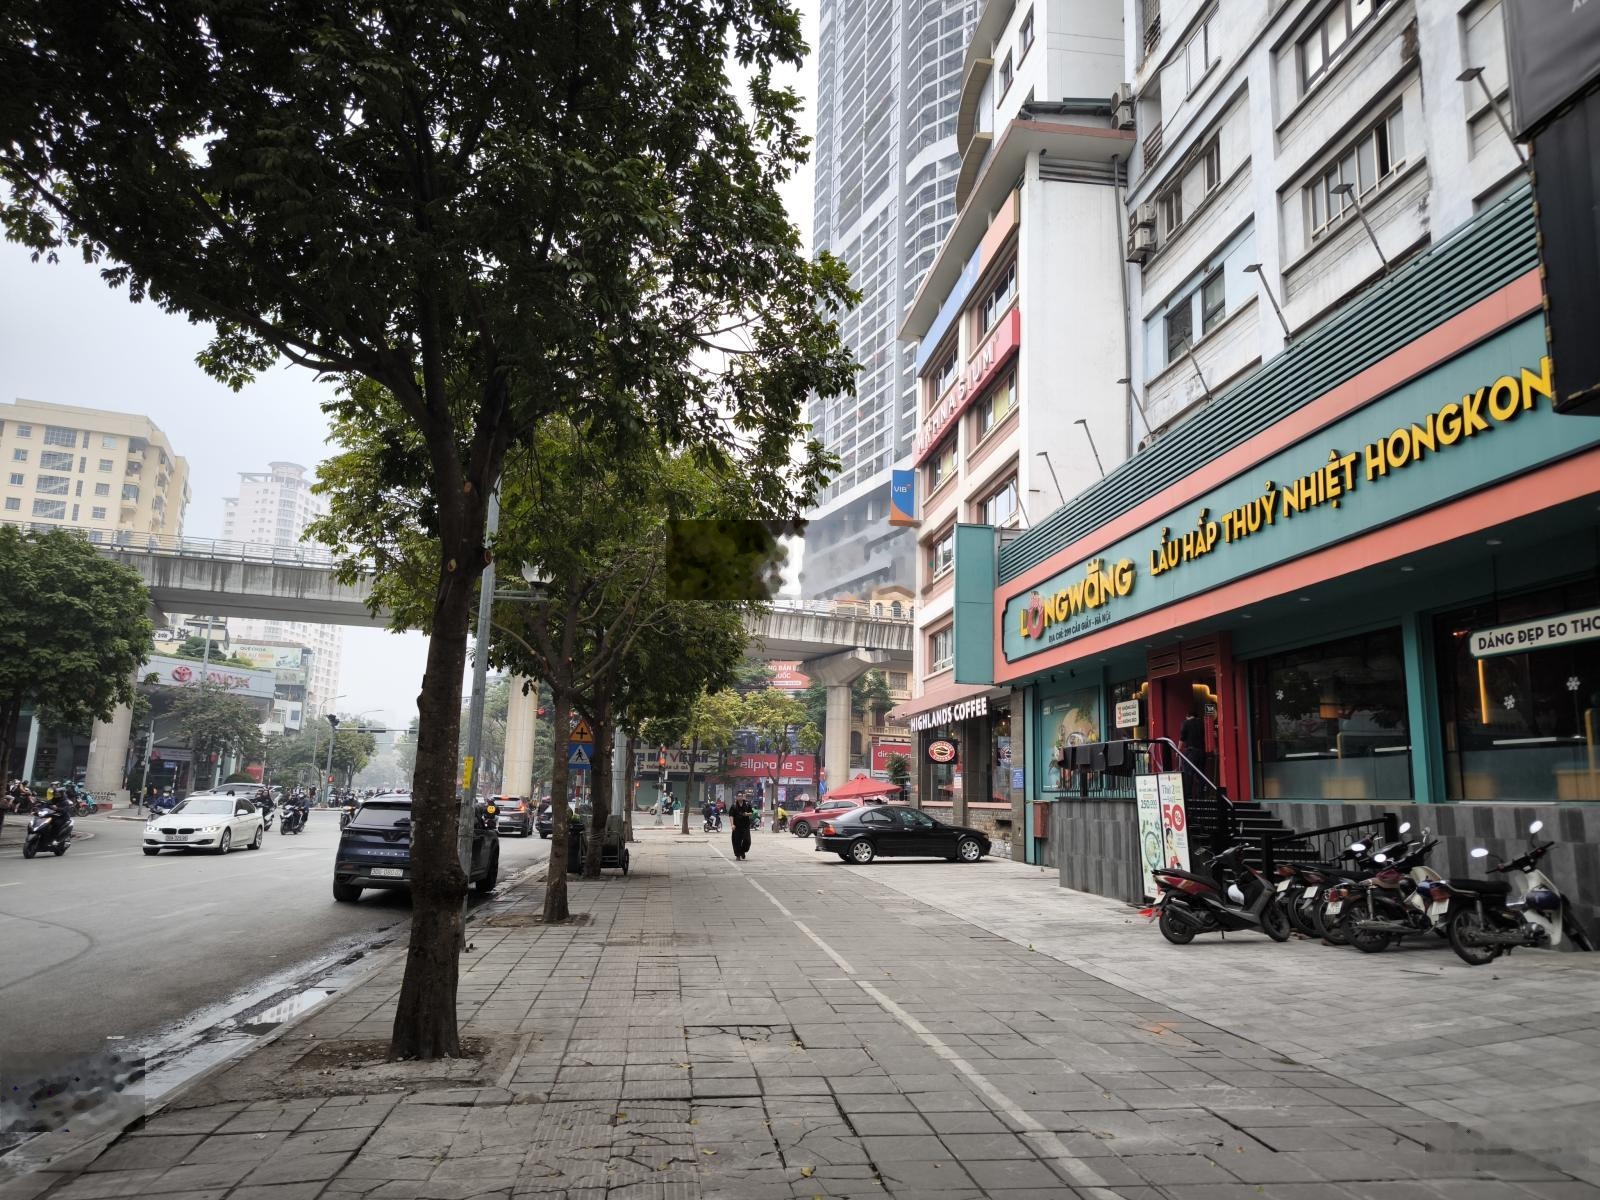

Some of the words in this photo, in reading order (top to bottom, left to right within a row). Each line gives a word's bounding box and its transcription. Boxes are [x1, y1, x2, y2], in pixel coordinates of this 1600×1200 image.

[893, 485, 907, 493] VIB
[1150, 527, 1181, 576] LẨU
[1183, 508, 1219, 562] HẤP
[1221, 480, 1278, 544] THUỶ
[1282, 449, 1359, 518] NHIỆT
[1478, 631, 1515, 650] DÁNG
[1518, 626, 1544, 646] ĐẸP
[1548, 622, 1567, 639] EO
[911, 706, 953, 733] HIGHLANDS
[953, 696, 988, 721] COFFEE
